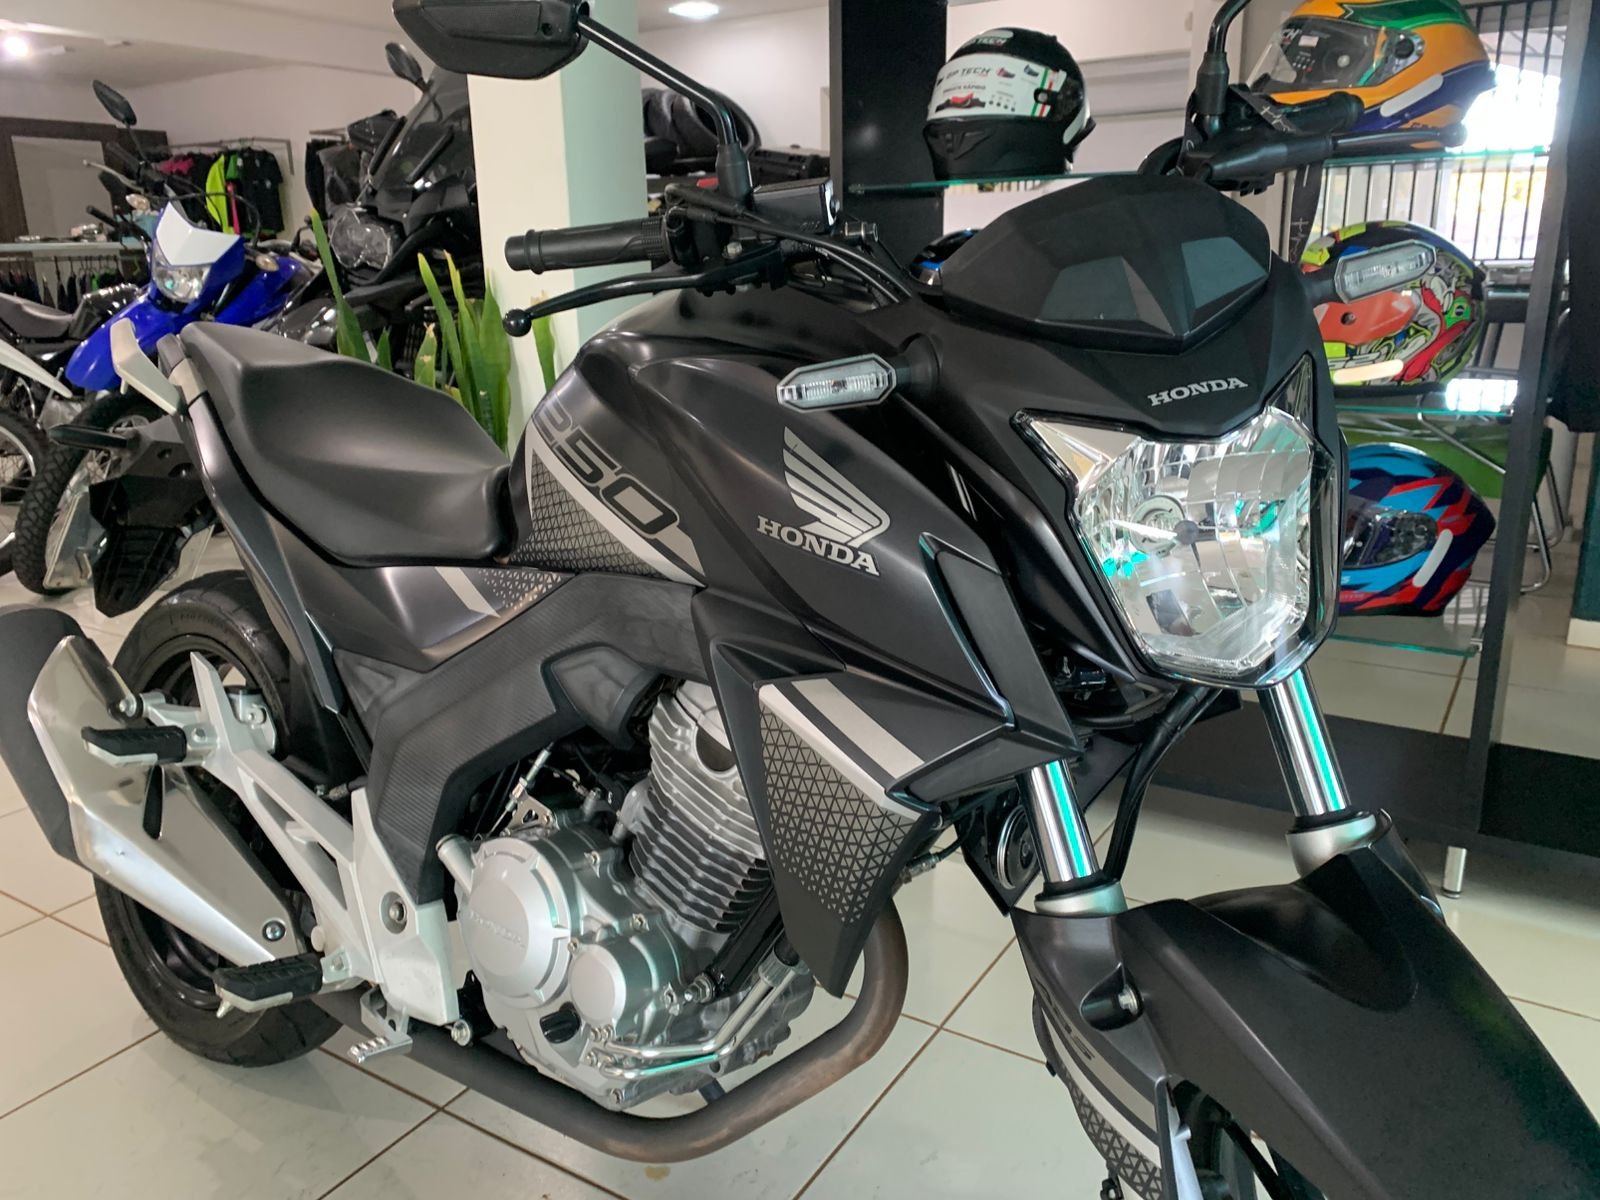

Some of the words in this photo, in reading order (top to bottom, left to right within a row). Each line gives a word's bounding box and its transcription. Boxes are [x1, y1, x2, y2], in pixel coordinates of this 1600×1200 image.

[961, 66, 992, 77] TECH
[1147, 377, 1248, 406] HONDA
[532, 394, 680, 539] 250
[756, 514, 881, 577] HONDA
